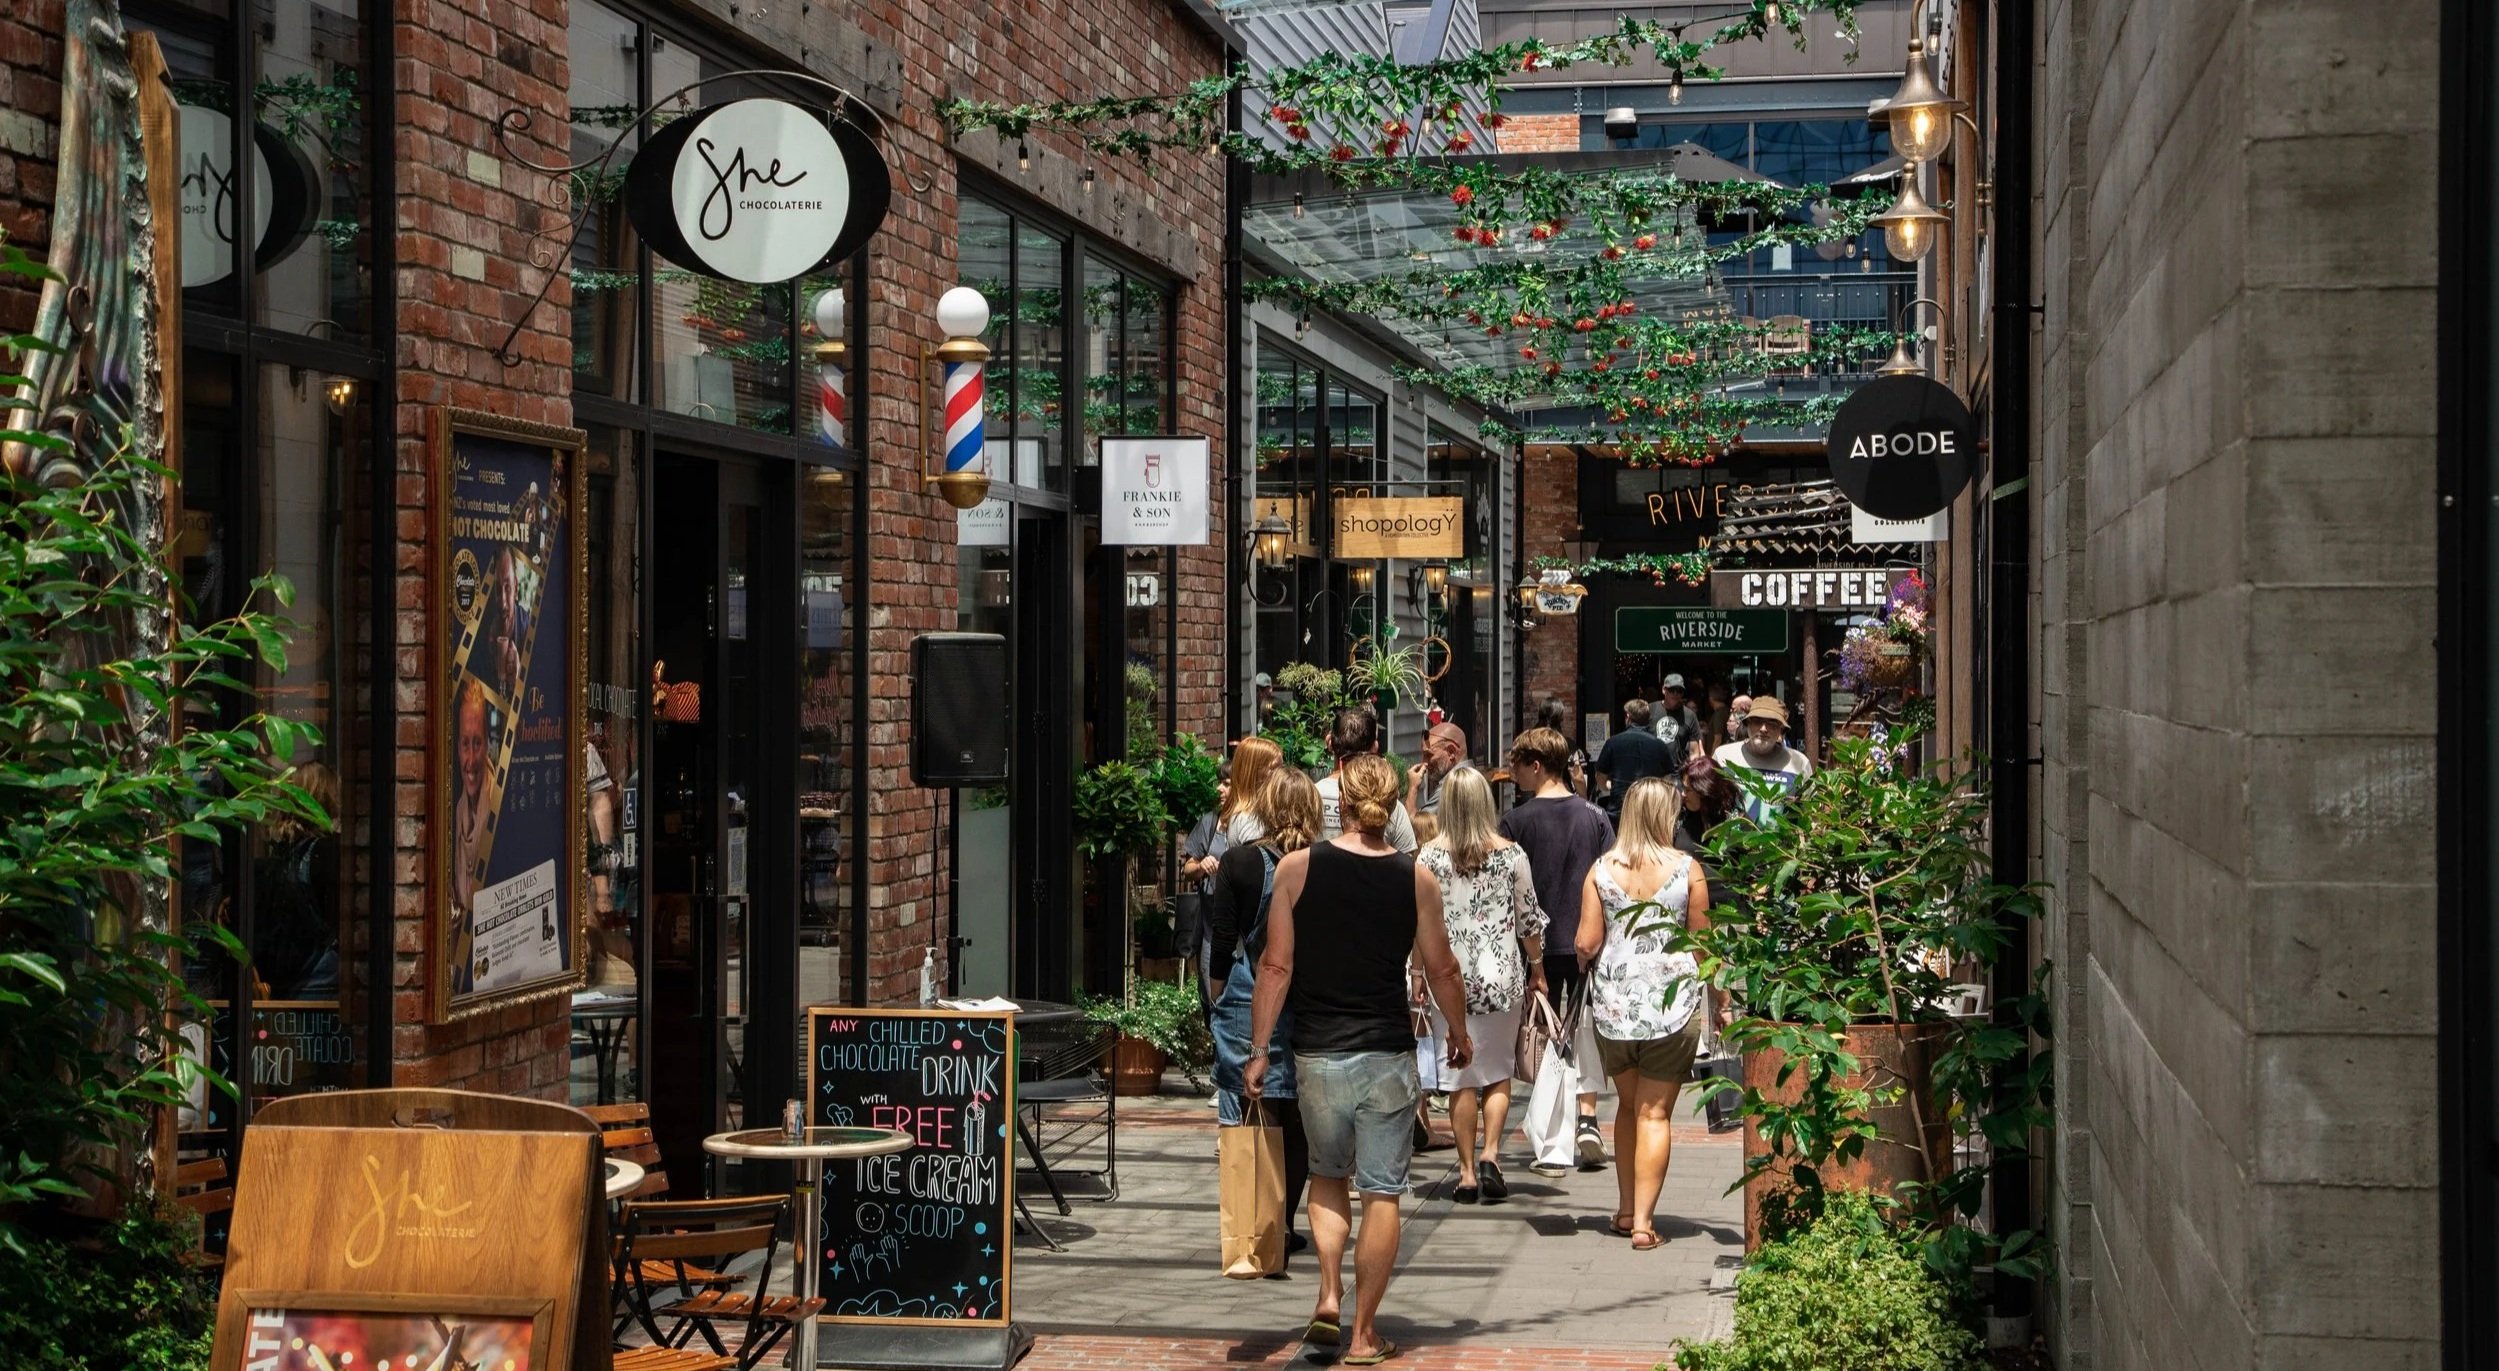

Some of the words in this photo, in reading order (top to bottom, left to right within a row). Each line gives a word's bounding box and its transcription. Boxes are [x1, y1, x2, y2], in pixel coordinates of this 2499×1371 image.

[696, 137, 807, 241] She
[739, 200, 823, 210] CHOCOLATERIE
[1849, 430, 1956, 459] ABODE
[497, 500, 510, 514] loved
[1123, 491, 1182, 502] FRANKIE
[1133, 506, 1142, 518] &
[1146, 507, 1171, 518] SON
[473, 518, 530, 543] CHOCOLATE
[1741, 572, 1887, 606] COFFEE
[1675, 611, 1704, 619] WELCOME
[1707, 611, 1715, 619] TO
[1716, 611, 1727, 619] THE
[1659, 621, 1745, 641] RIVERSIDE
[528, 686, 545, 714] Be
[494, 884, 513, 904] NEW
[512, 872, 538, 894] TIMES
[495, 909, 517, 926] CHOCOLATE
[829, 1019, 859, 1033] ANY
[869, 1020, 946, 1046] CHILLED
[820, 1043, 921, 1073] CHOCOLATE
[922, 1056, 1000, 1097] DRINK
[860, 1094, 888, 1105] WITH
[871, 1106, 956, 1150] FREE
[857, 1155, 900, 1195] ICE
[909, 1155, 997, 1206] CREAM
[345, 1154, 473, 1269] She
[895, 1203, 965, 1240] SCOOP
[396, 1226, 477, 1239] CHOCOLATERIE
